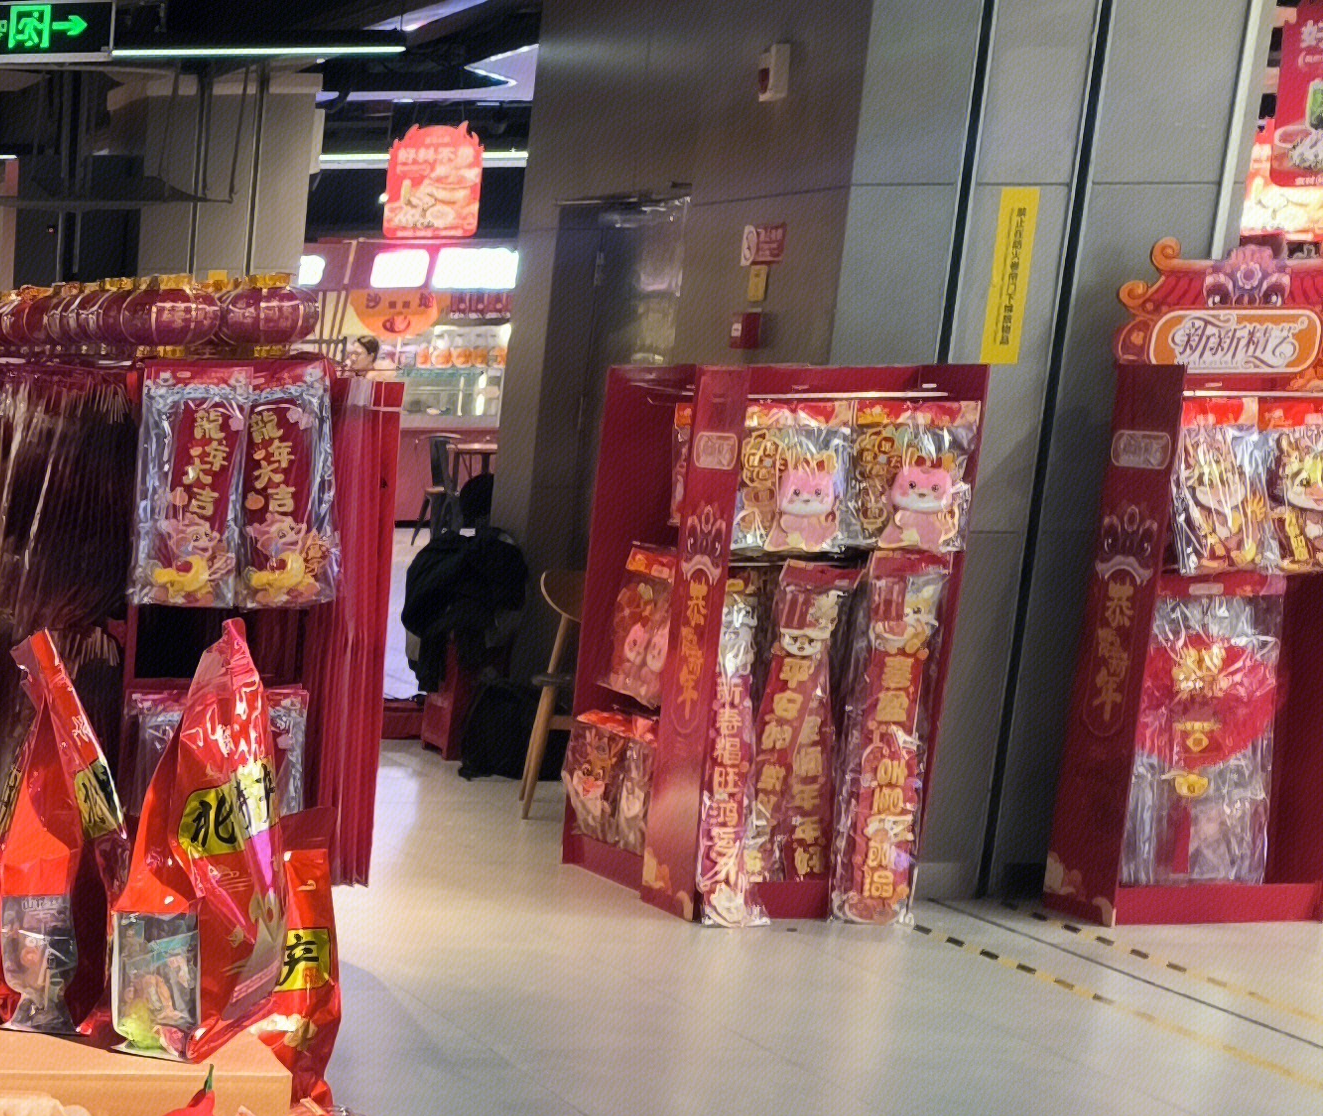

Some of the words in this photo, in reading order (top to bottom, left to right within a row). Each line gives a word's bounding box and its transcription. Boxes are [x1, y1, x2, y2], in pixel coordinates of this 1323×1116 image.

[183, 409, 229, 516] 龍年大吉
[250, 411, 295, 513] 龍年大吉
